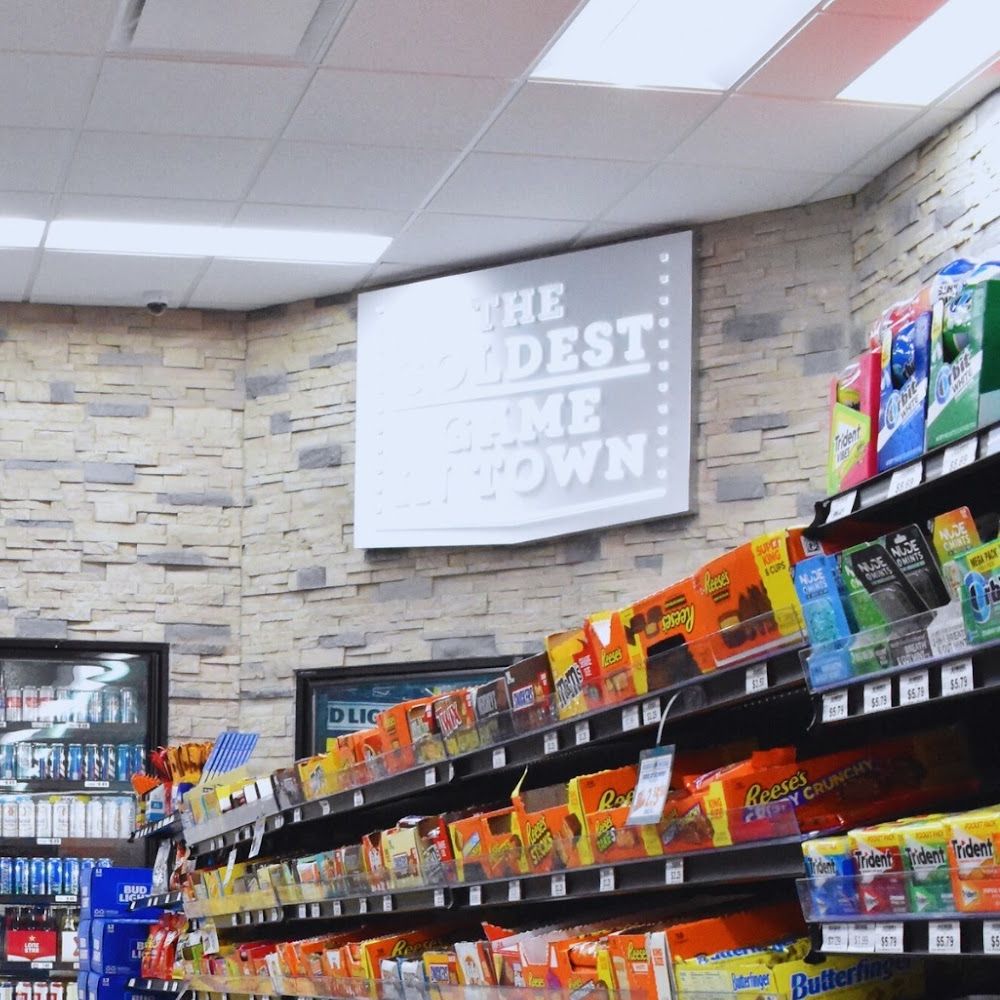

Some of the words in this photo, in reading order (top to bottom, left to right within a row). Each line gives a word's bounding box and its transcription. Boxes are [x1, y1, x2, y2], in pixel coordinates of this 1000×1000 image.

[473, 282, 564, 332] THE
[952, 370, 974, 394] WHITE
[901, 394, 920, 419] WHITE
[446, 387, 602, 455] GAME
[834, 424, 861, 447] Trident
[474, 433, 647, 499] TOWN
[762, 550, 782, 566] KING
[771, 562, 786, 576] CUPS
[969, 553, 985, 569] MEGA
[985, 547, 999, 561] PACK
[704, 569, 731, 595] Reese's
[964, 571, 1000, 623] Orb
[601, 647, 622, 668] Reese's
[950, 676, 968, 690] $5.79
[436, 701, 462, 738] TWIX
[744, 770, 809, 807] Reese's
[803, 759, 876, 801] CRUNCHY
[855, 849, 893, 869] Trident
[904, 846, 945, 867] Trident
[951, 837, 993, 860] Trident
[807, 856, 836, 876] Trident
[123, 885, 149, 896] BUD
[881, 936, 897, 947] $5.79
[936, 936, 954, 947] $5.79
[731, 970, 771, 991] Butterfinger
